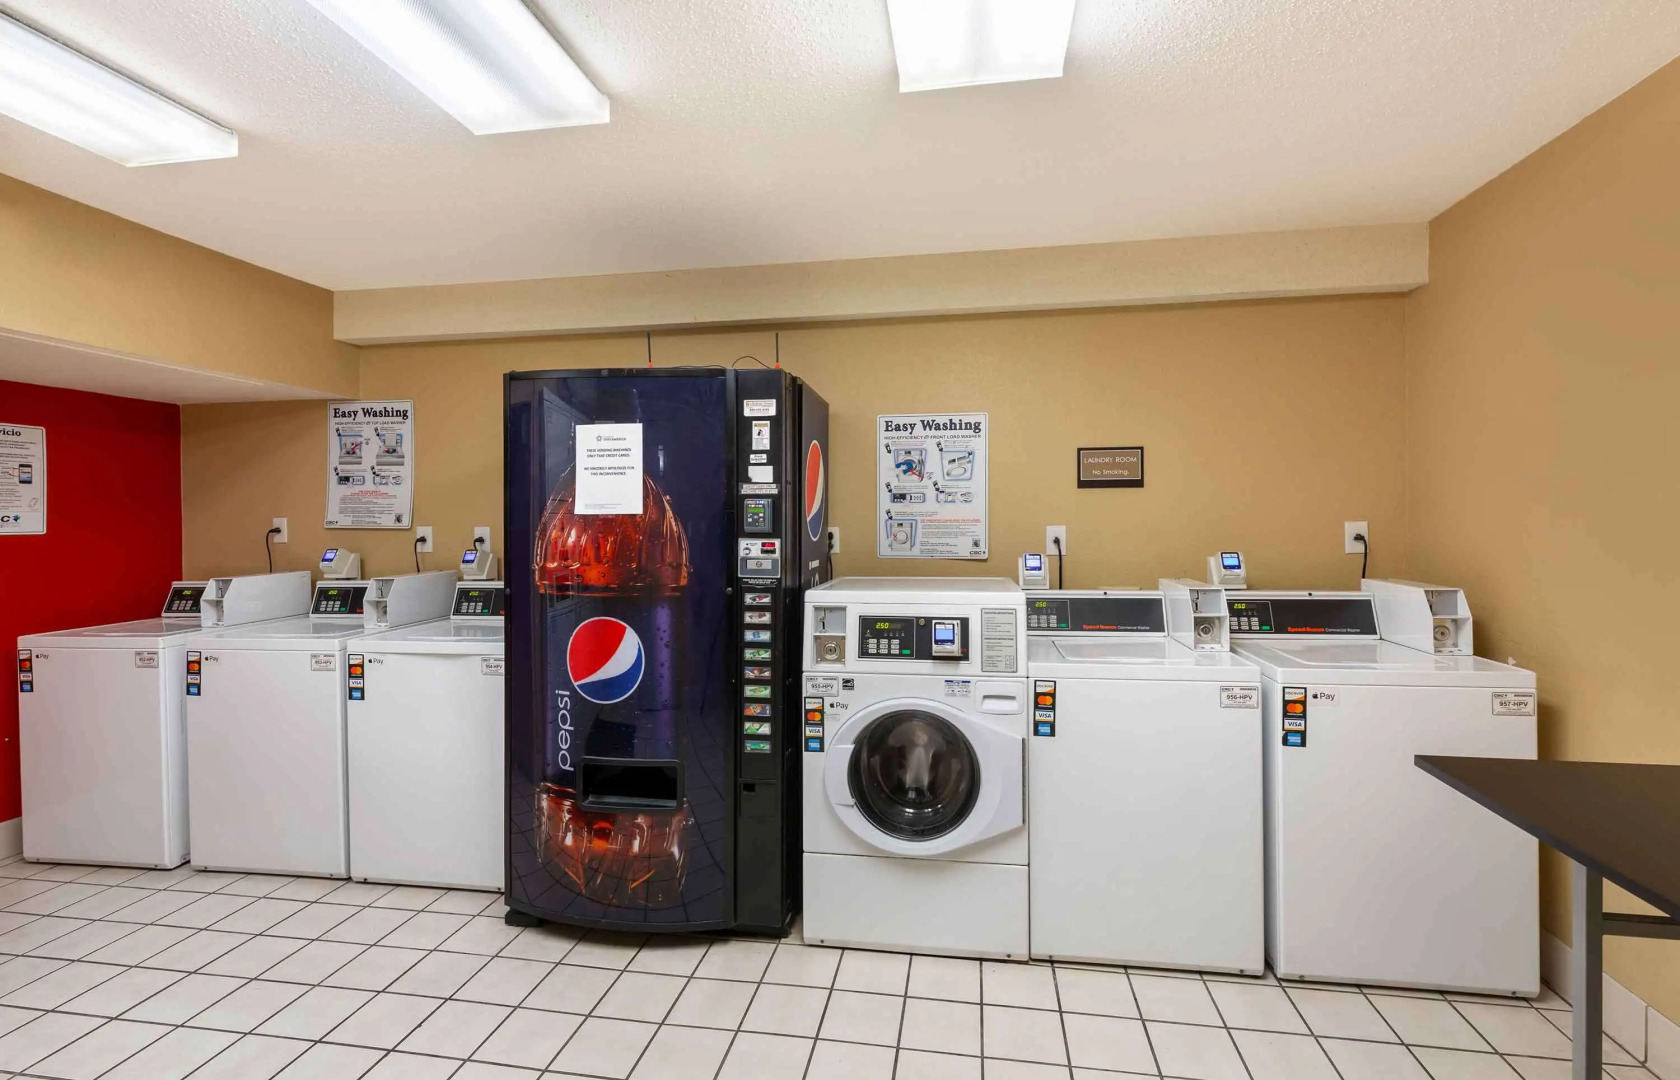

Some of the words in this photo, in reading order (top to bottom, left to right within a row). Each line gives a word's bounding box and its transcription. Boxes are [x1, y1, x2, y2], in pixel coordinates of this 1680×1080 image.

[333, 407, 359, 421] Easy
[361, 406, 409, 420] Washing
[884, 420, 917, 435] Easy
[920, 418, 982, 434] Washing
[1320, 692, 1336, 702] Pay
[836, 702, 849, 710] Pay
[556, 690, 574, 771] pepsi
